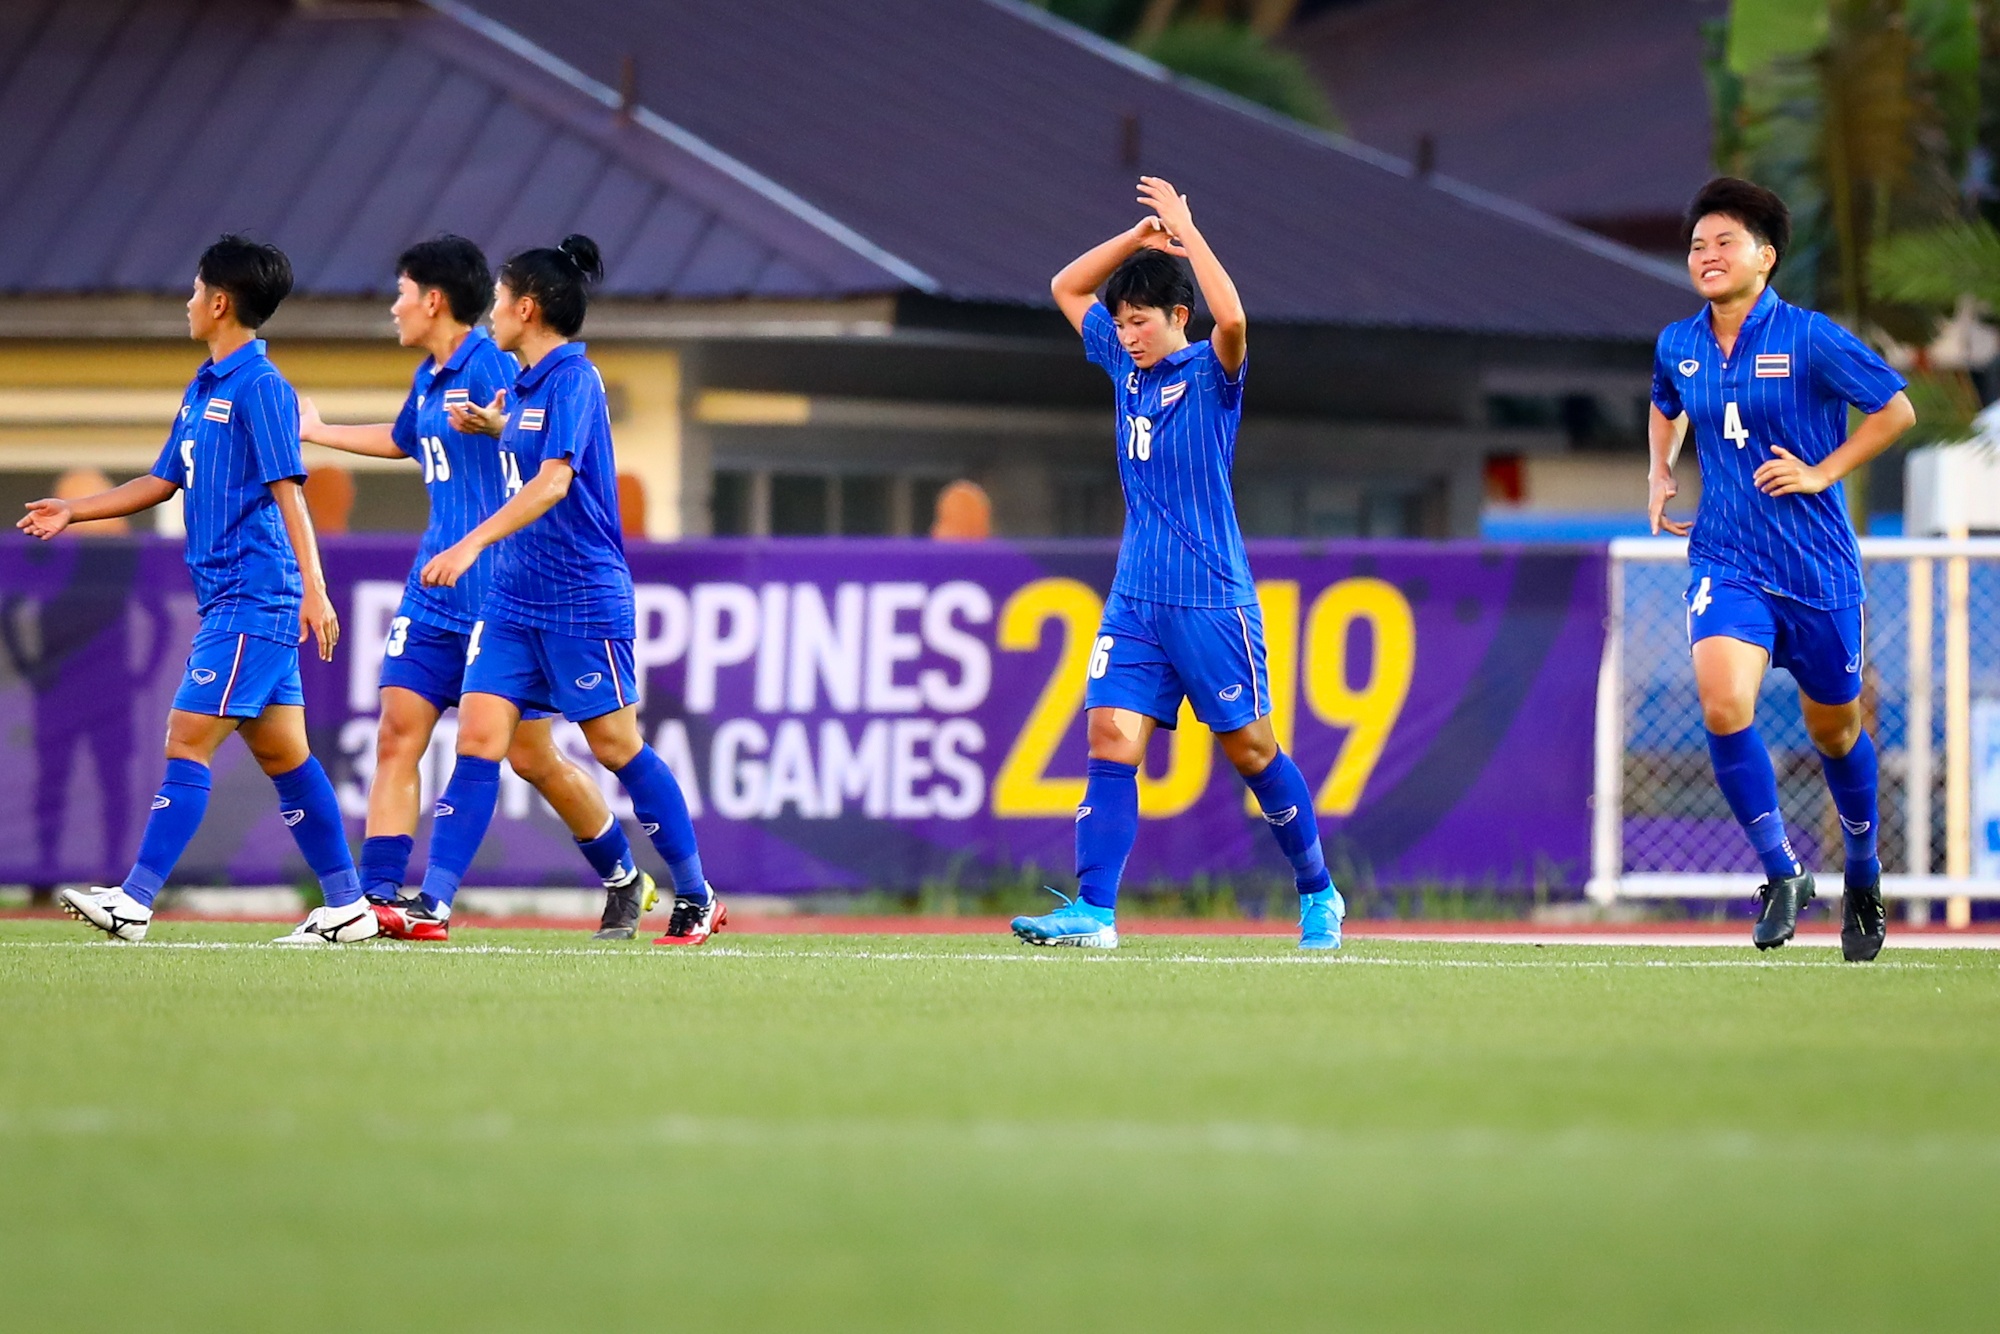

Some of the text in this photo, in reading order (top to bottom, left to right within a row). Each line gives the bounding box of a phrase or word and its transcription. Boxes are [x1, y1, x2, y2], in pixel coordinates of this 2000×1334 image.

[1126, 415, 1153, 462] 16
[1724, 401, 1750, 450] 4
[420, 436, 451, 484] 13
[499, 451, 523, 498] 14
[1691, 577, 1713, 616] 4
[346, 580, 994, 712] PPPINES
[385, 616, 411, 657] 3
[710, 718, 986, 821] GAMES
